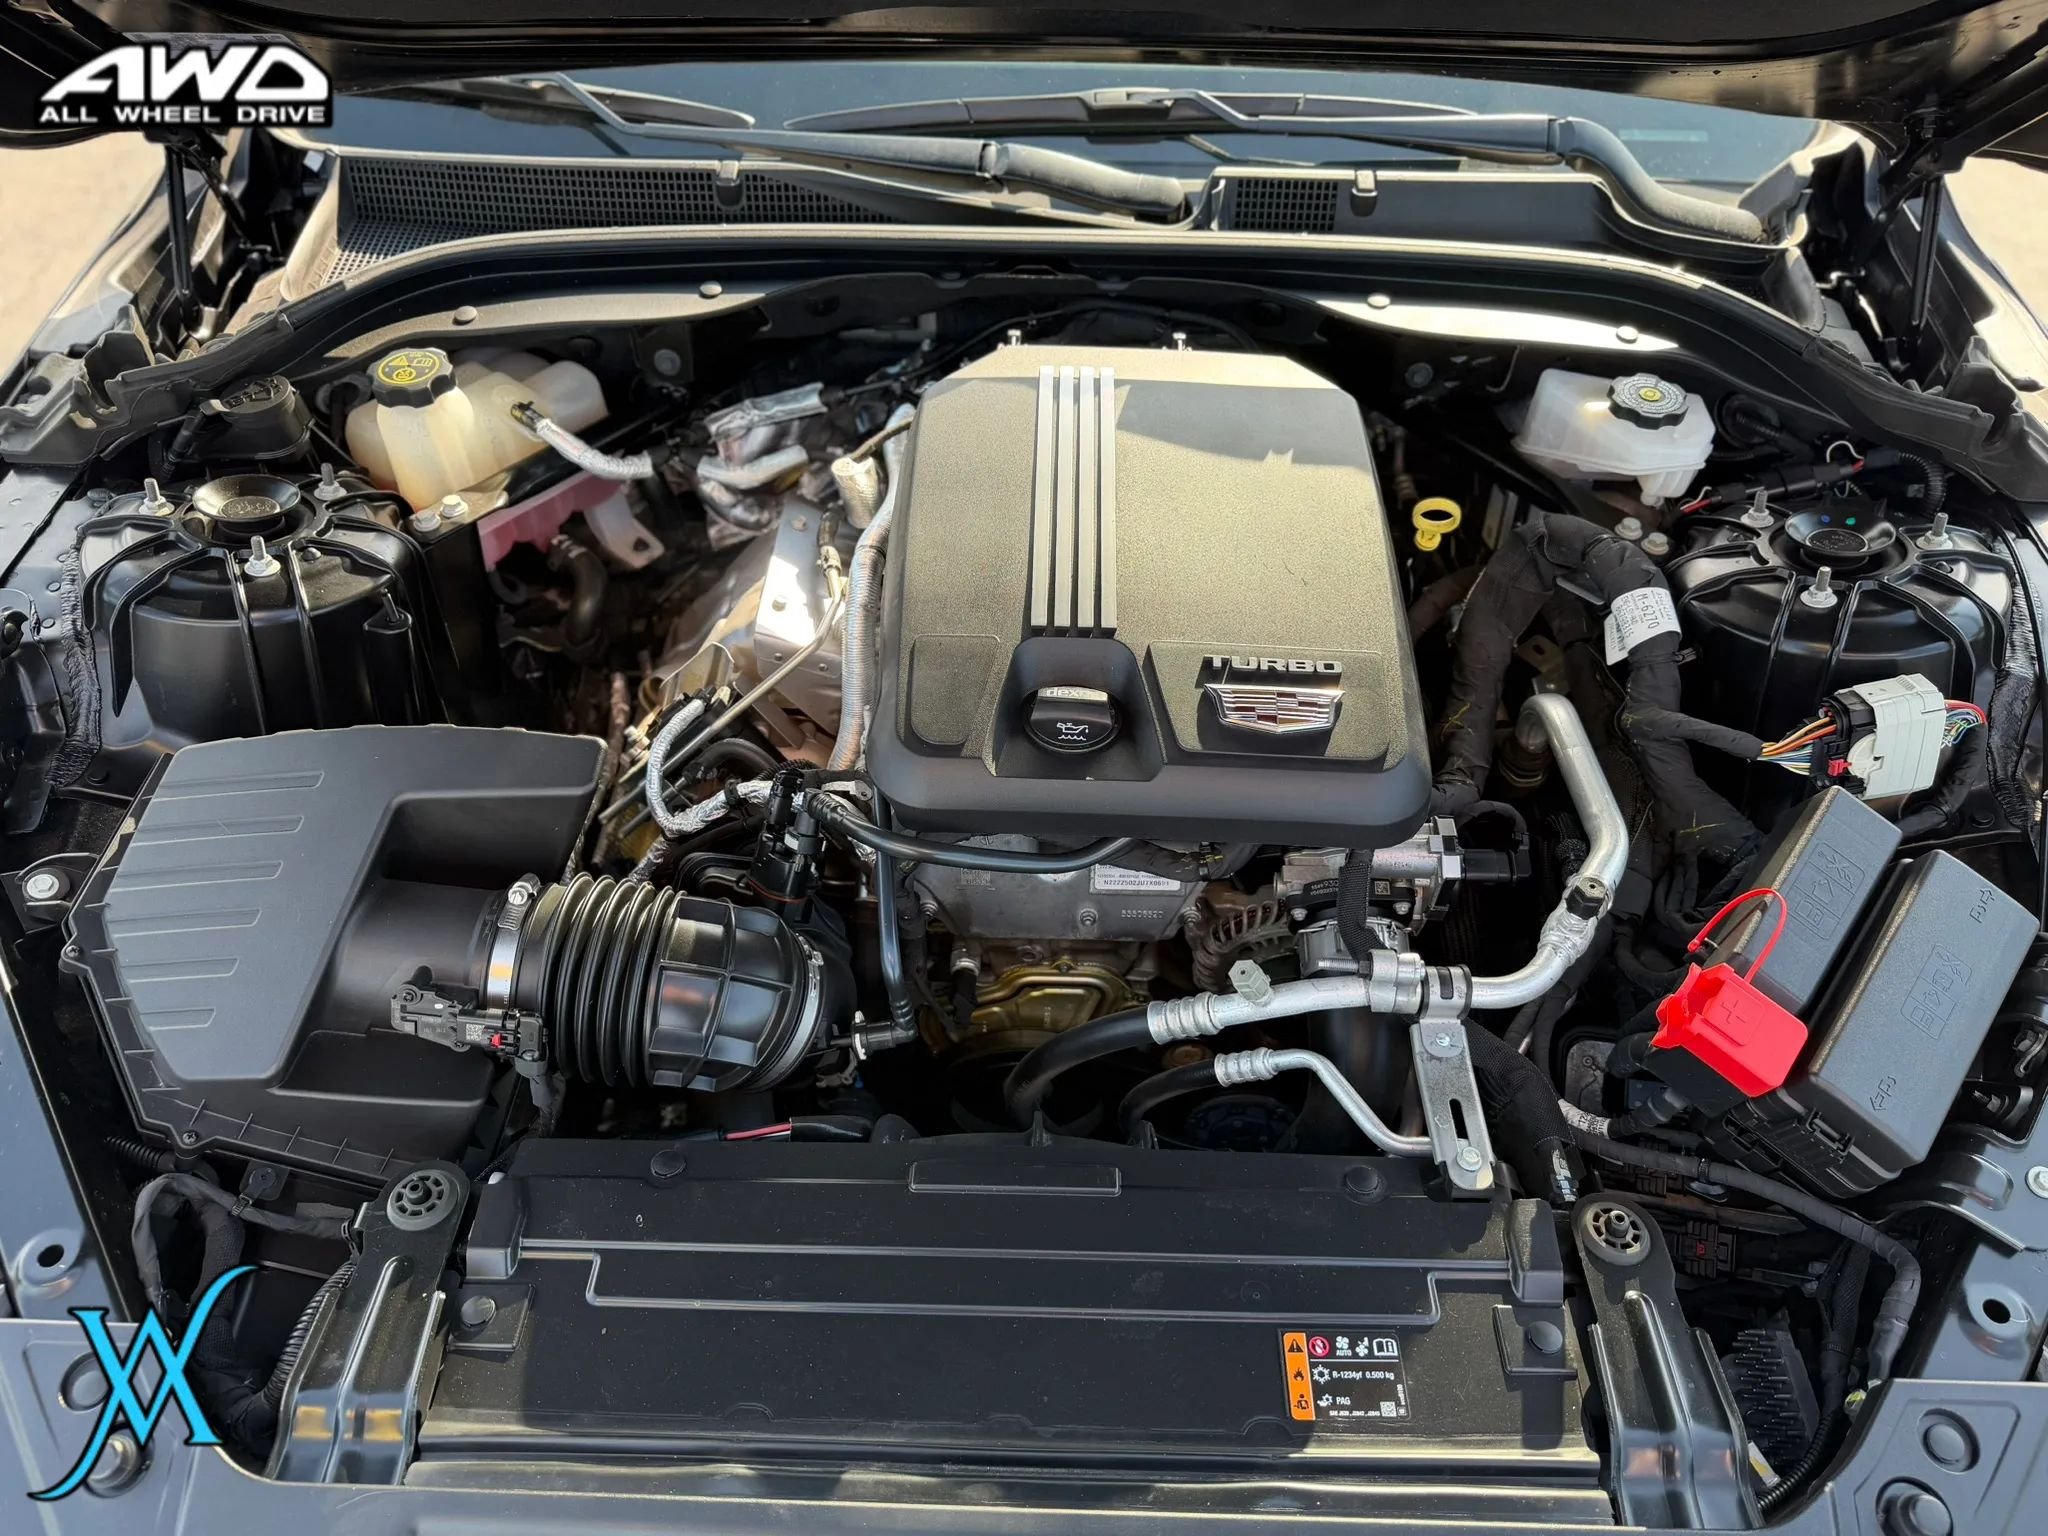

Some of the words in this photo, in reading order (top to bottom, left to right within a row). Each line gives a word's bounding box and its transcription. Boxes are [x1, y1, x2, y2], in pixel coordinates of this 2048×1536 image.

[1204, 654, 1343, 673] TURBO
[1332, 1370, 1363, 1380] R-1234yf
[1365, 1370, 1385, 1379] 0.500
[1385, 1371, 1395, 1380] kg
[1336, 1396, 1351, 1405] PAG
